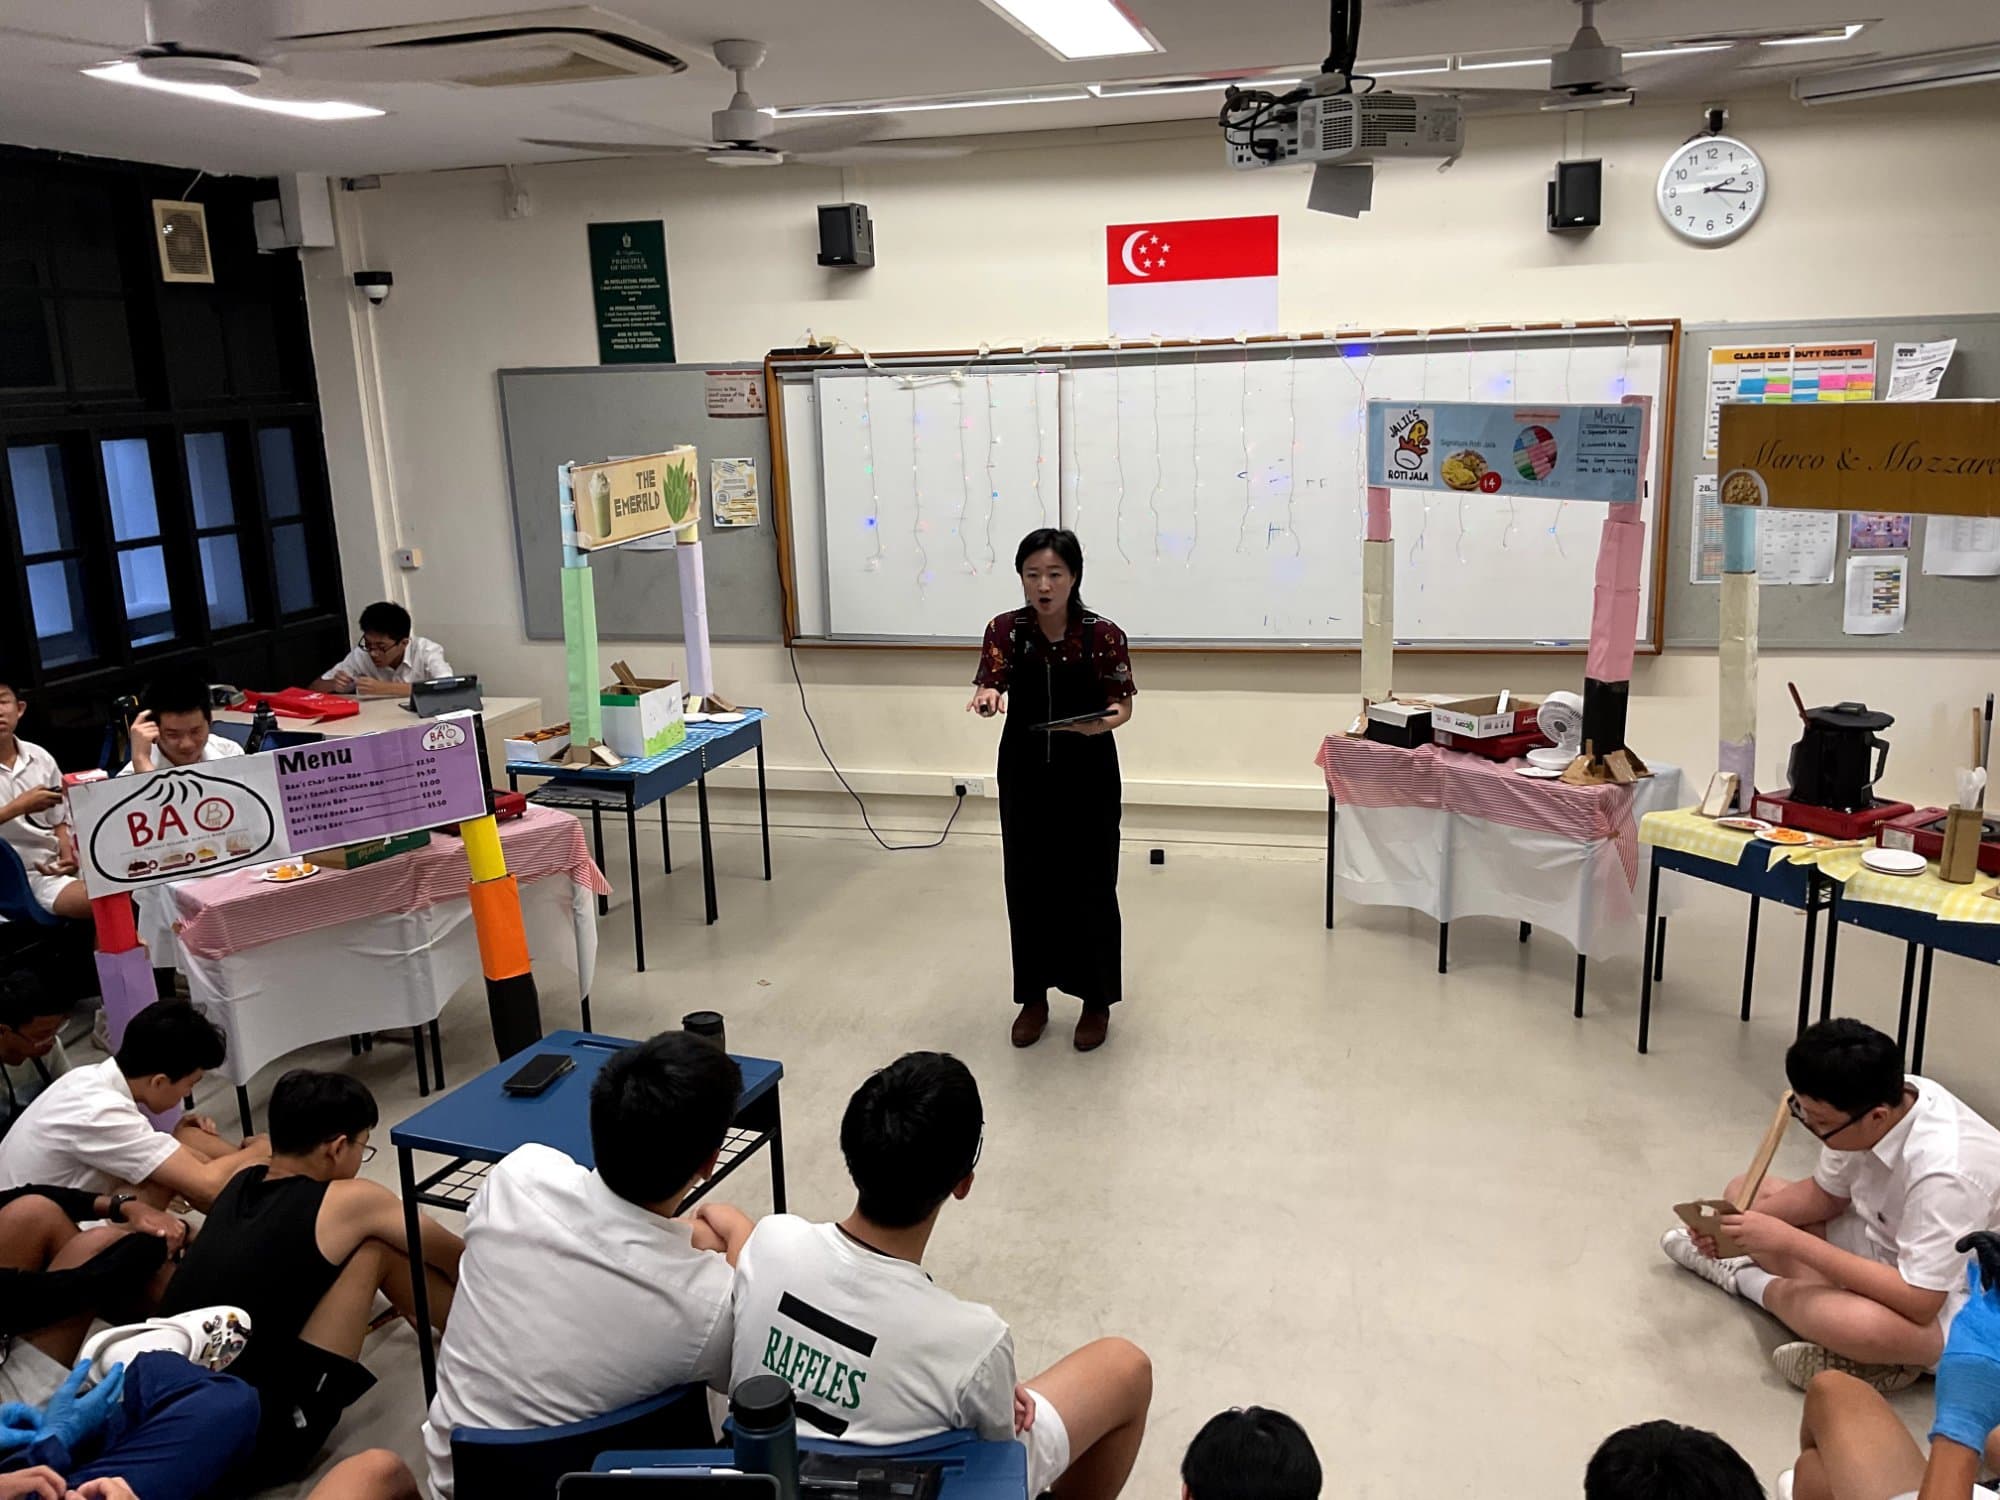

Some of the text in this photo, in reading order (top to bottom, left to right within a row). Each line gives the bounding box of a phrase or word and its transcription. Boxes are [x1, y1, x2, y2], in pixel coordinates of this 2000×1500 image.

[1706, 148, 1718, 159] 12
[1728, 152, 1733, 162] 1
[1688, 156, 1698, 165] 11
[1676, 169, 1688, 180] 10
[1741, 164, 1749, 175] 2
[1746, 181, 1754, 192] 3
[1669, 188, 1677, 198] 9
[1674, 205, 1682, 216] 8
[1739, 201, 1746, 211] 4
[1688, 216, 1696, 227] 7
[1725, 213, 1735, 224] 5
[1706, 220, 1714, 230] 6
[1734, 352, 1766, 360] CLASS
[1794, 350, 1821, 358] DUTY
[1823, 349, 1862, 357] ROSTER
[1594, 407, 1626, 425] Menu
[1388, 409, 1420, 438] JALIL'S
[1741, 440, 1825, 471] Marco
[1836, 447, 1861, 472] &
[636, 469, 656, 489] THE
[1388, 469, 1429, 481] ROTI JALA
[614, 491, 660, 517] EMERALD
[278, 748, 353, 775] Menu
[127, 797, 234, 848] BAO
[761, 1325, 867, 1410] RAFFLES
